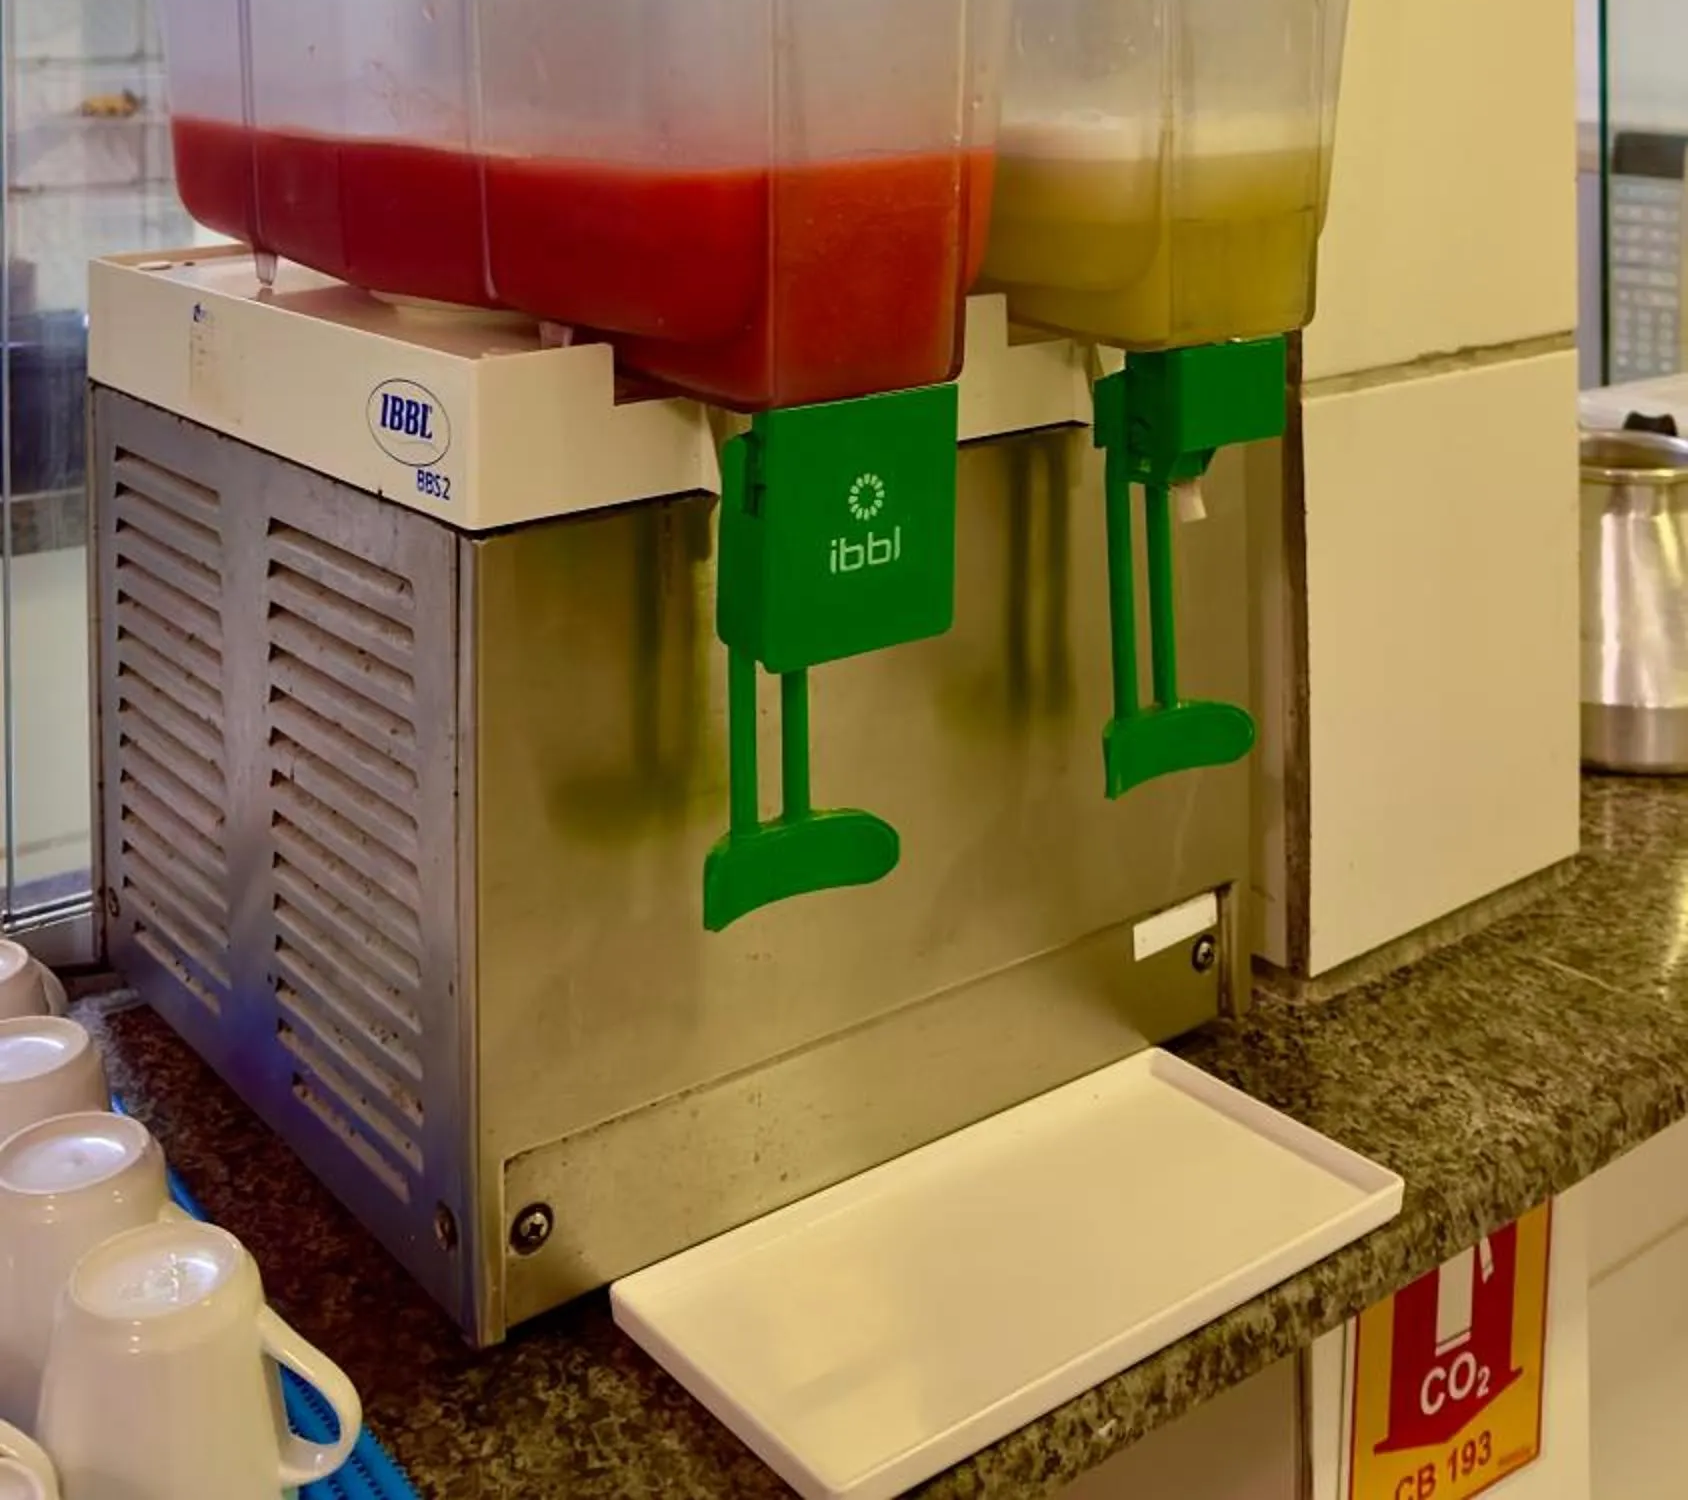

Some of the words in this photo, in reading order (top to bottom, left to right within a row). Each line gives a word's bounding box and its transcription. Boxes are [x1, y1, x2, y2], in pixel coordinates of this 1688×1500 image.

[380, 393, 433, 439] IBBL
[416, 469, 451, 500] BBS2
[830, 525, 901, 574] ibbl
[1394, 1462, 1436, 1500] CB
[1446, 1430, 1491, 1483] 193
